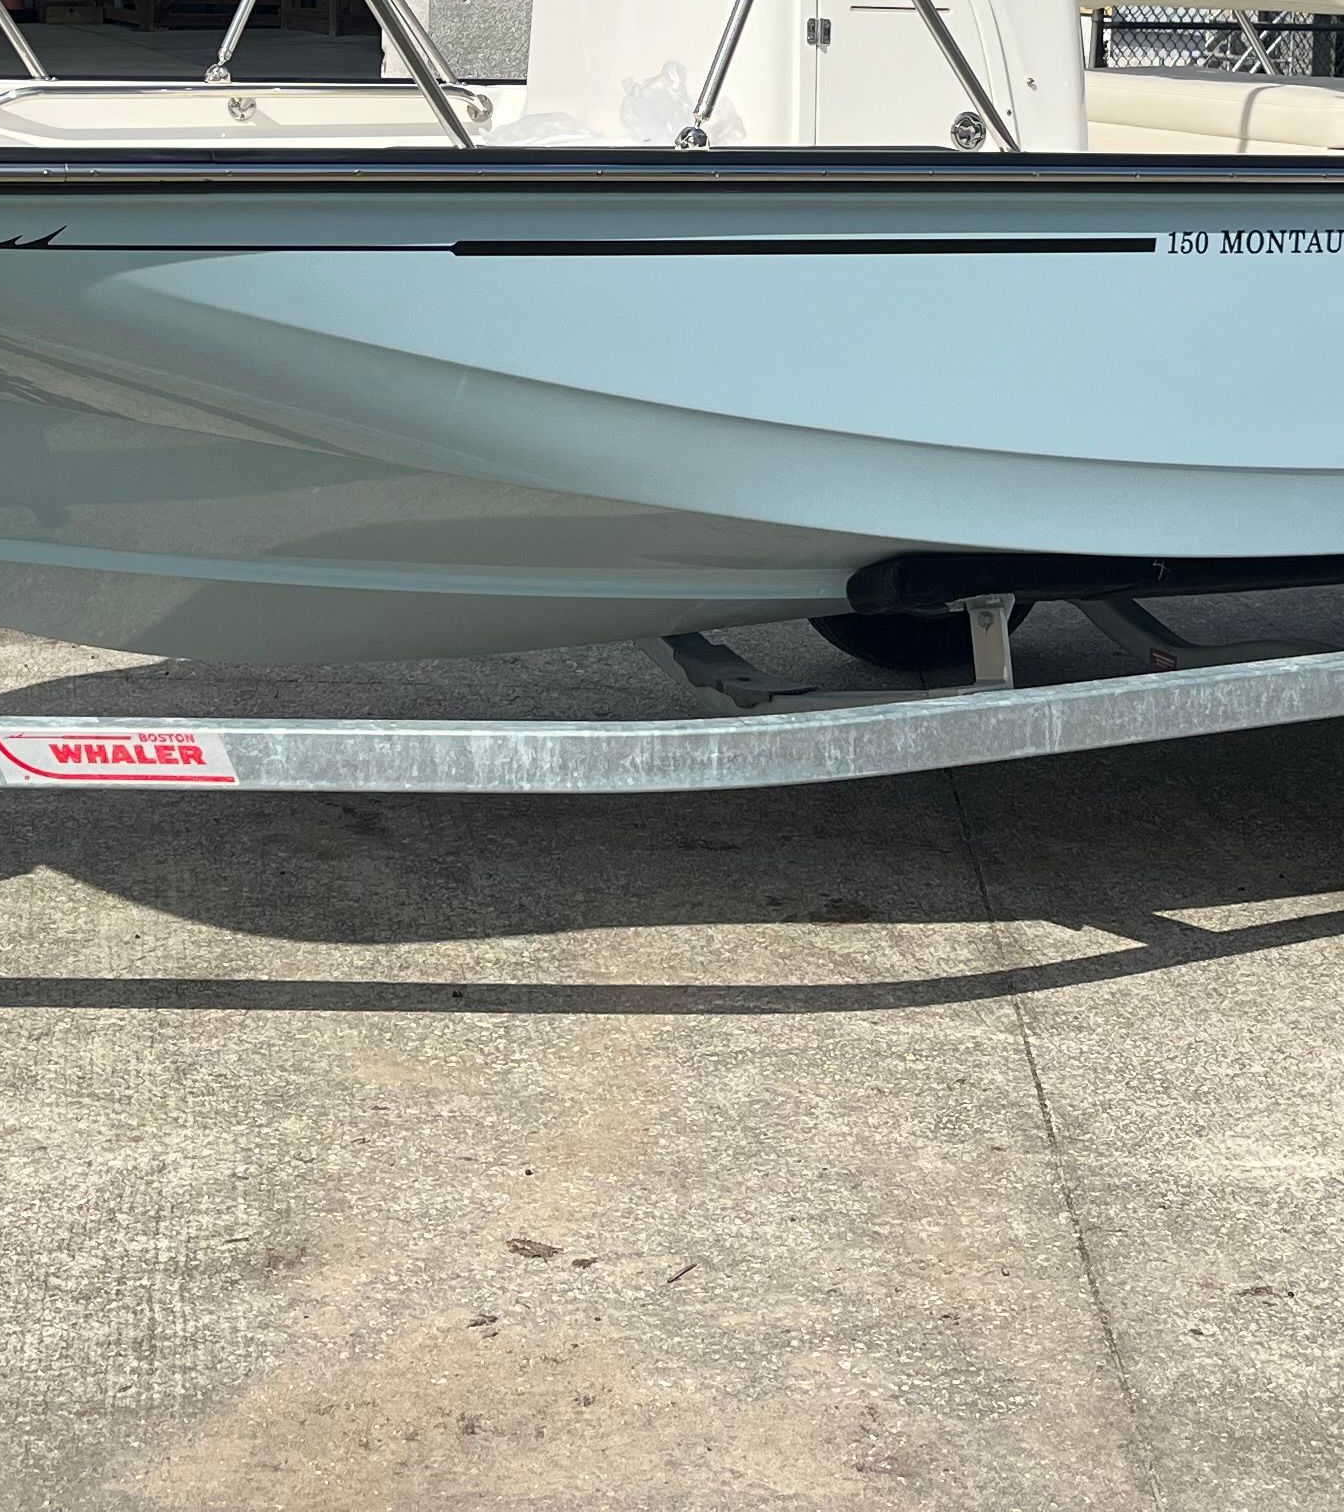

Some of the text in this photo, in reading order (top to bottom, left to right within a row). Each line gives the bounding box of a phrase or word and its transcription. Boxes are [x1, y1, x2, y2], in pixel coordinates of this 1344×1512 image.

[1167, 231, 1209, 254] 150
[138, 733, 196, 744] BOSTON
[48, 743, 207, 765] WHALER
